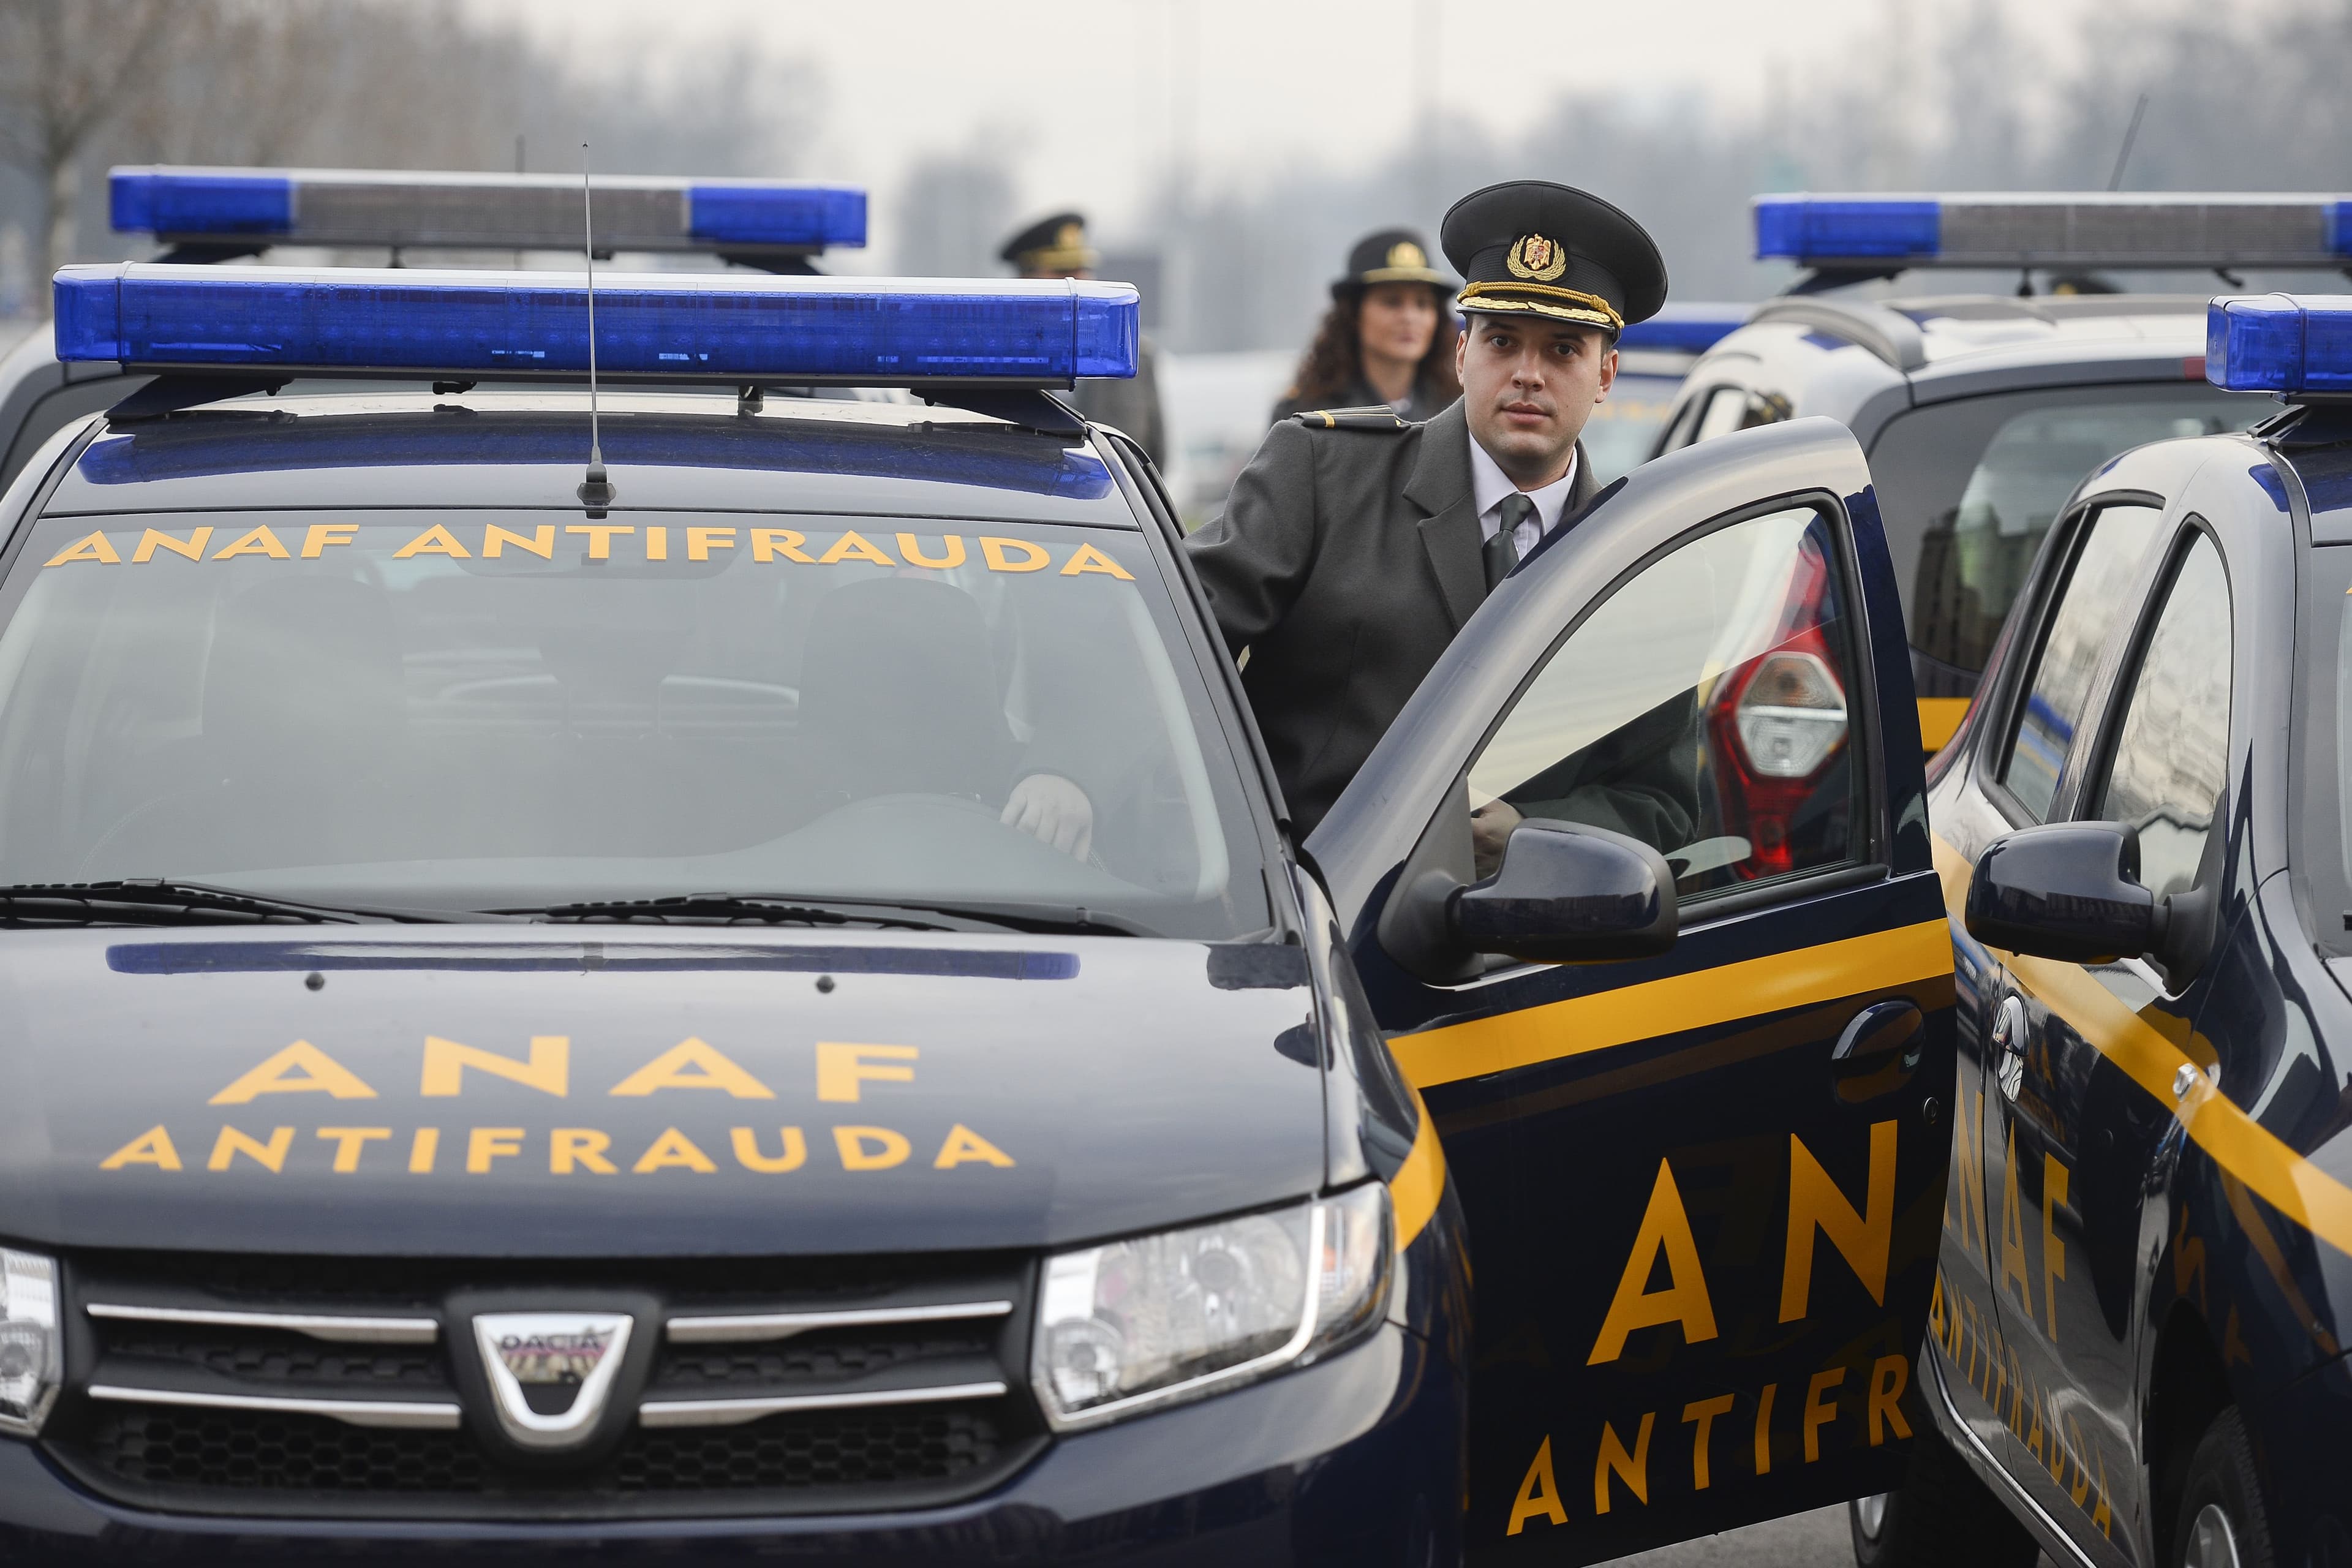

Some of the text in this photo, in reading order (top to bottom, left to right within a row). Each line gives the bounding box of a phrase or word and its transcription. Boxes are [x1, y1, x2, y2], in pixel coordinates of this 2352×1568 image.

[43, 523, 1134, 581] ANAF ANTIFRAUDA
[100, 1125, 1014, 1173] ANTIFRAUDA
[209, 1036, 917, 1105] ANAF
[1586, 1119, 1898, 1366] AN
[1943, 1068, 2069, 1344] NAF
[1506, 1354, 1913, 1536] ANTIFR
[1929, 1268, 2111, 1542] ANTIFRAUDA
